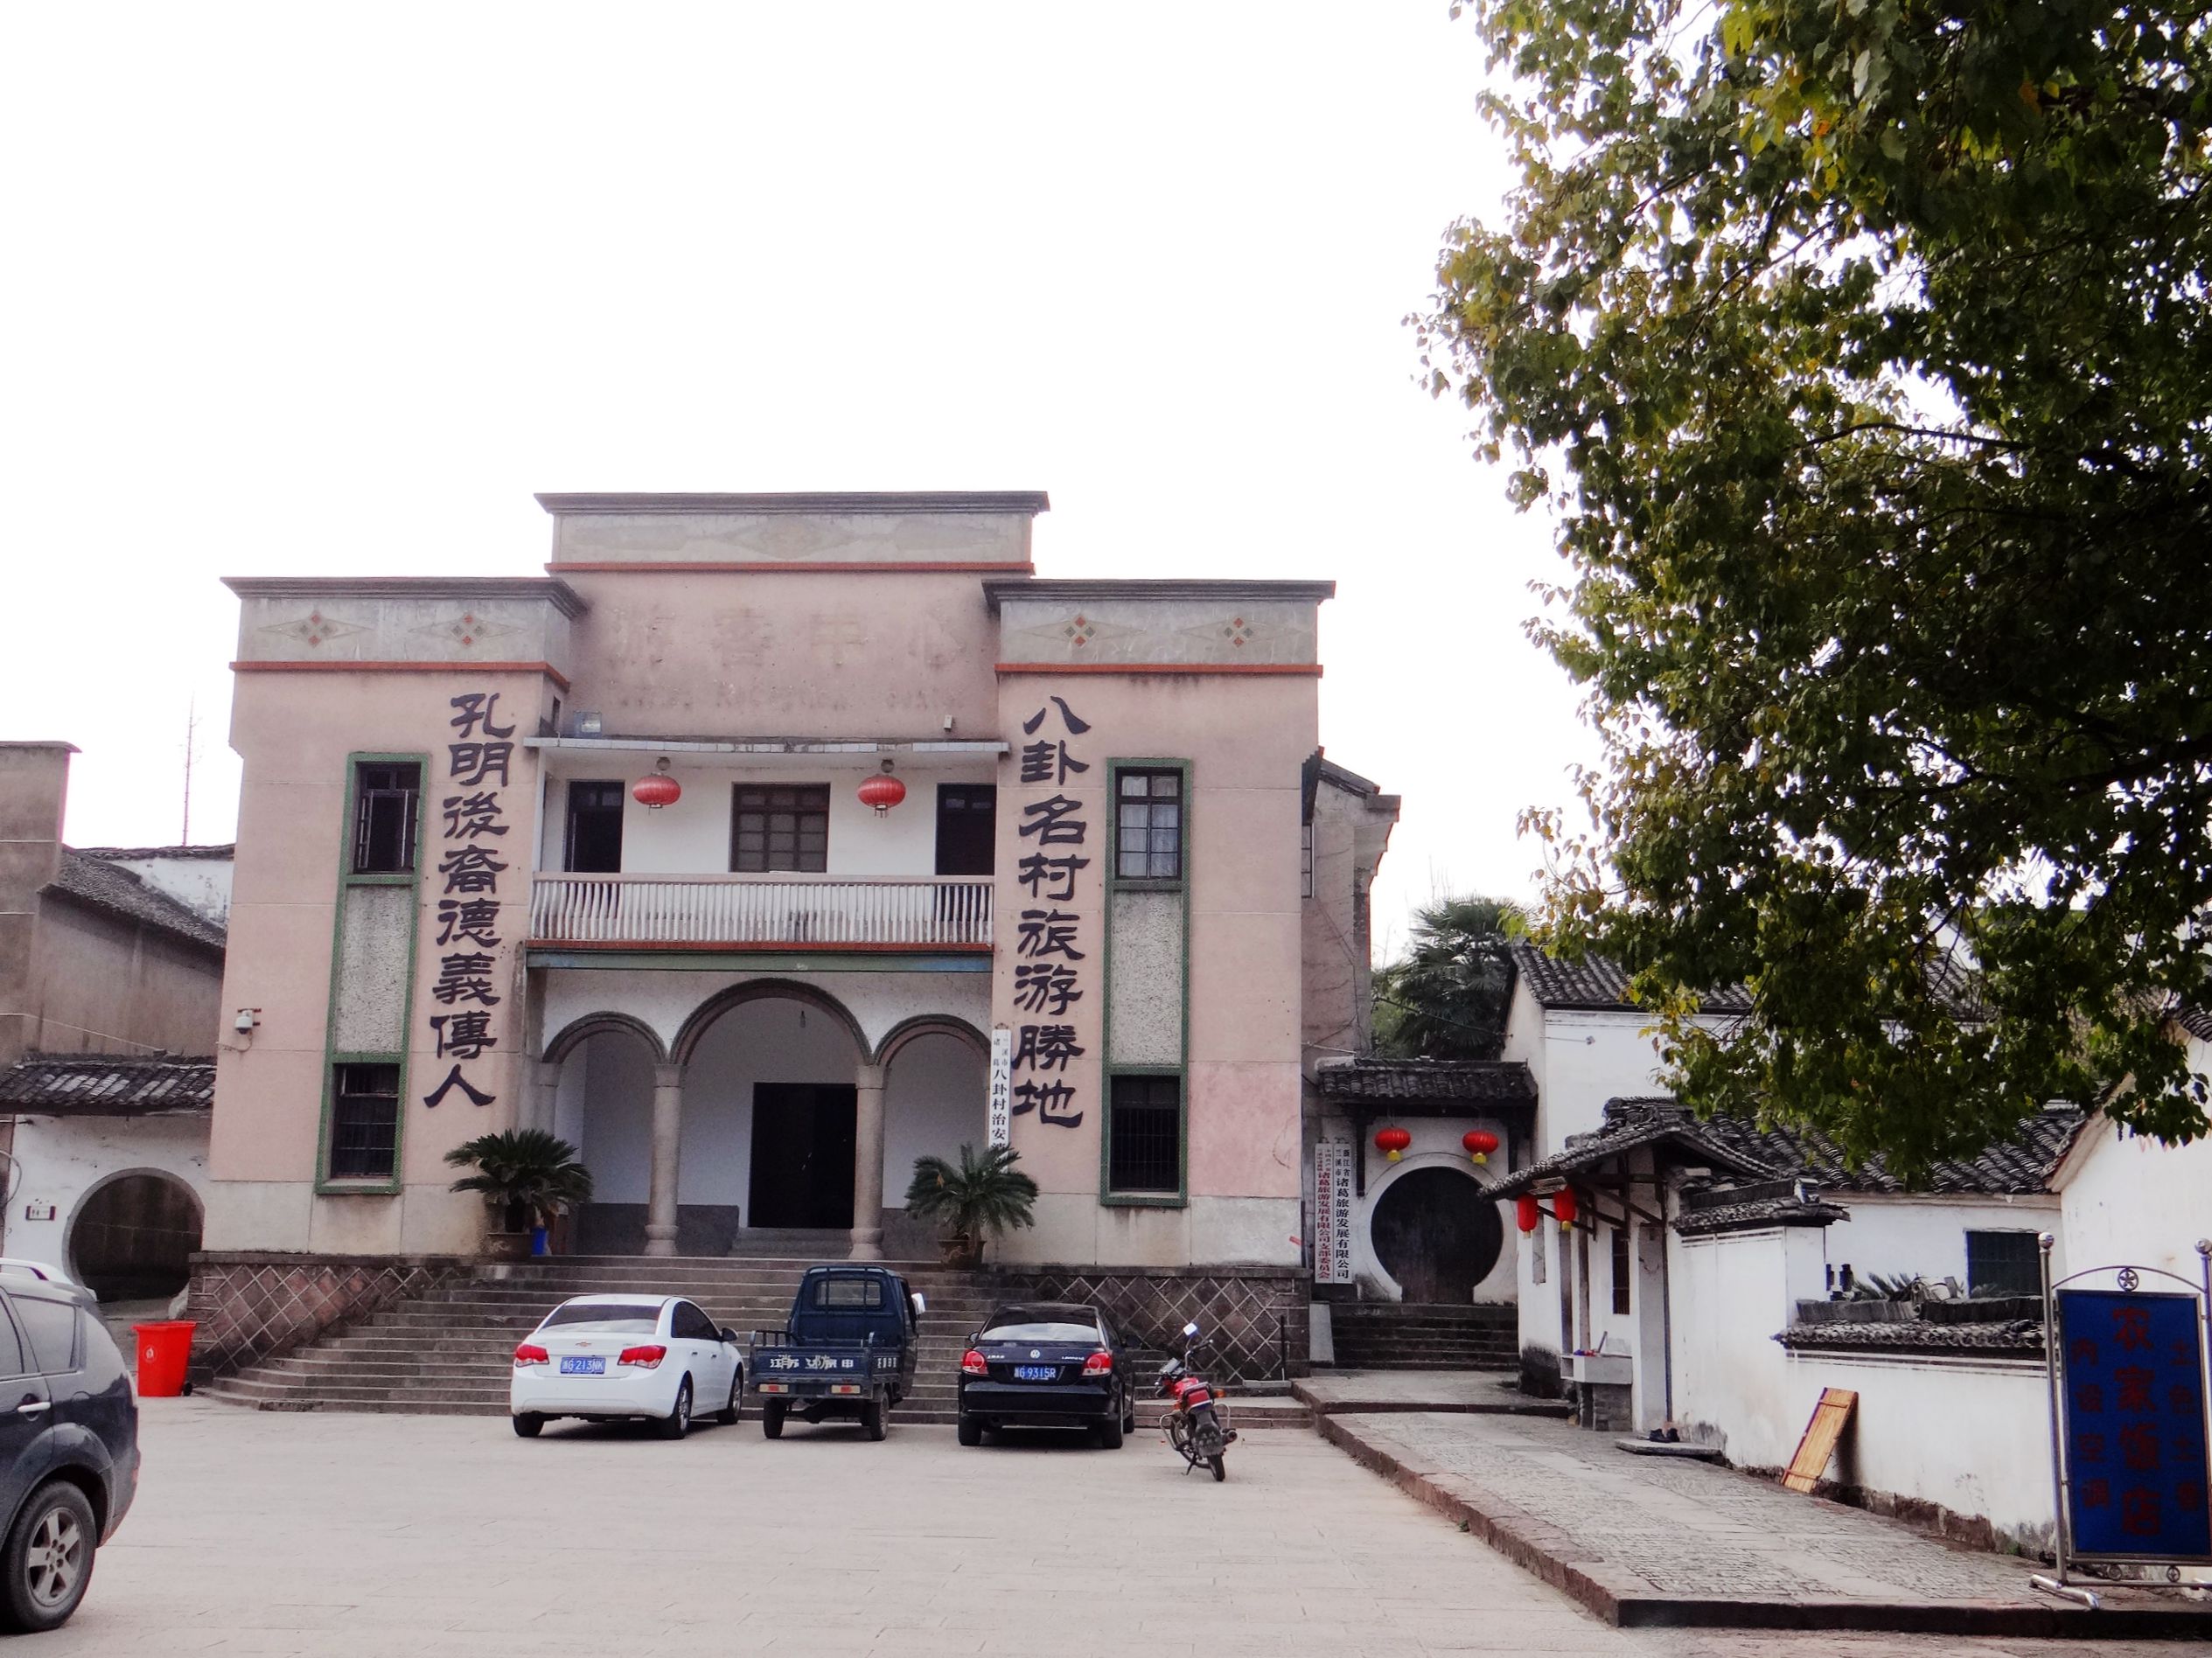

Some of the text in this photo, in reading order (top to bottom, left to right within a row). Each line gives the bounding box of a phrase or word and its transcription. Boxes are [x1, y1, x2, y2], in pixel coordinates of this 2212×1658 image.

[423, 693, 516, 1109] 孔明後裔德義傳人
[1012, 695, 1092, 1129] 八卦名村旅游勝地
[1336, 1178, 1350, 1279] 诸葛旅游发展有限公司
[2111, 1306, 2160, 1536] 农家饭店
